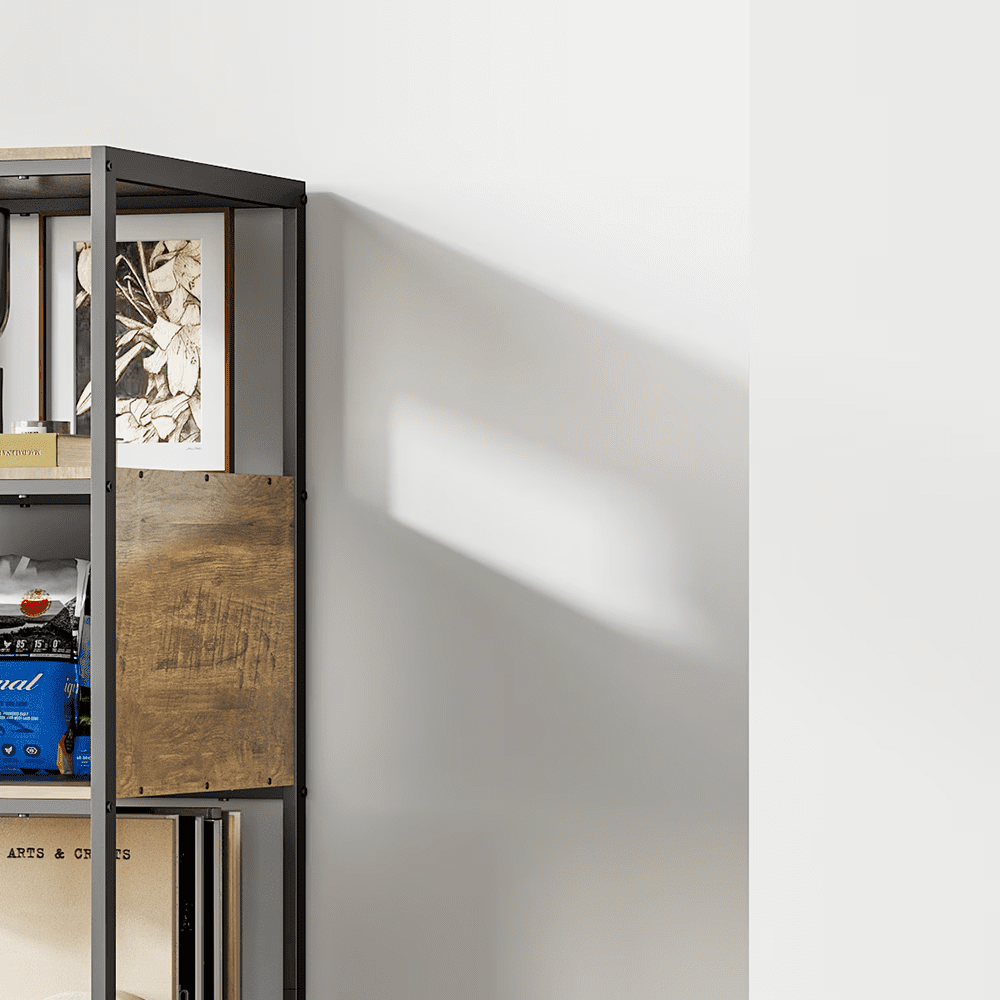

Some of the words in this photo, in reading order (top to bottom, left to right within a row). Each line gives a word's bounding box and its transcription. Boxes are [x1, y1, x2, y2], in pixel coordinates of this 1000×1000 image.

[7, 847, 45, 859] ARTS
[54, 848, 65, 859] &
[74, 848, 131, 860] CRTS
